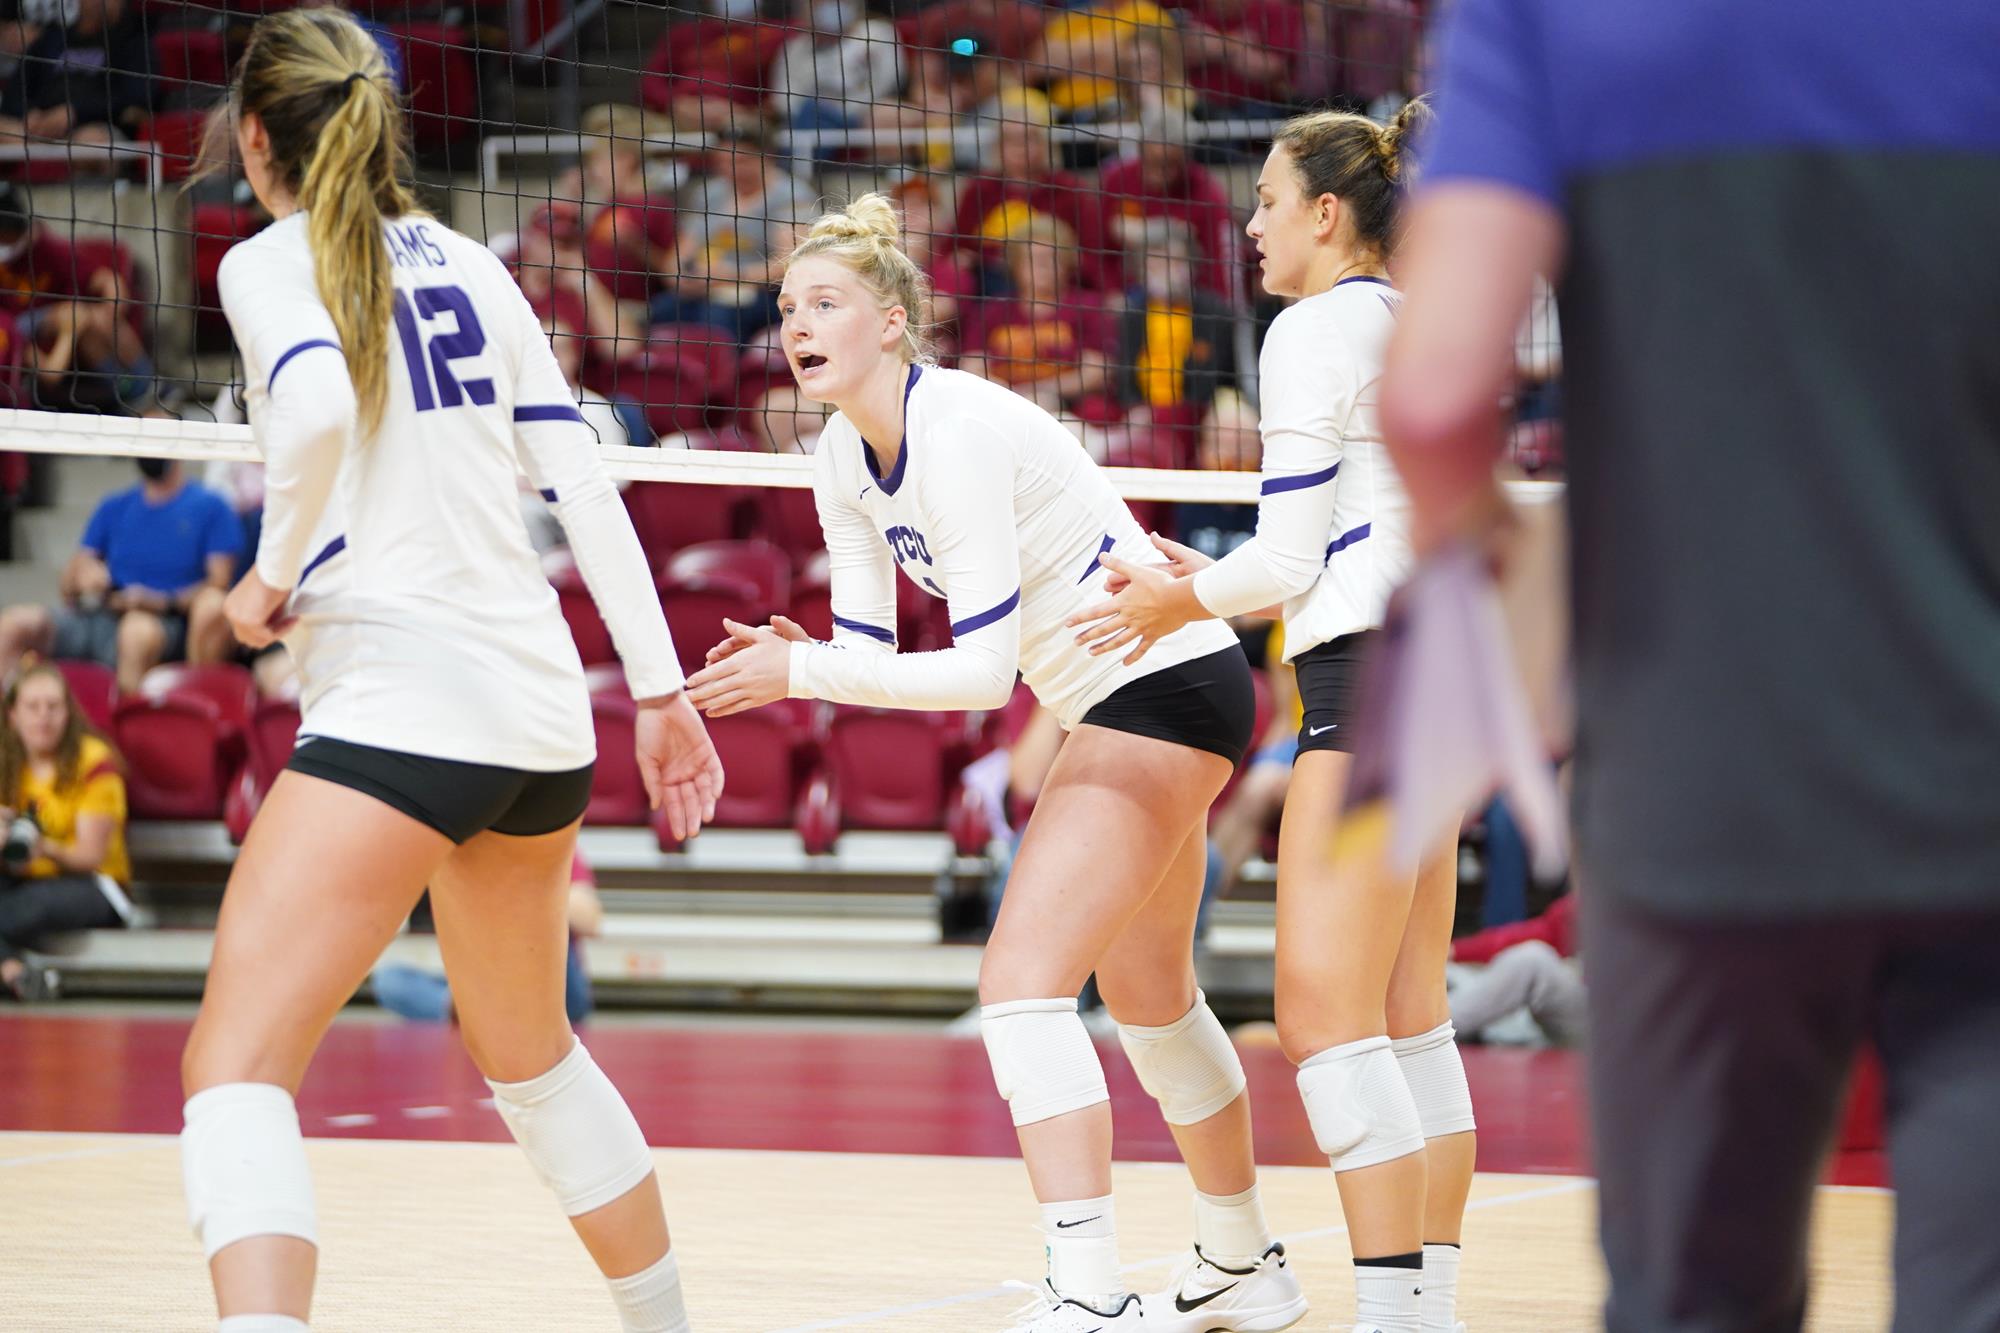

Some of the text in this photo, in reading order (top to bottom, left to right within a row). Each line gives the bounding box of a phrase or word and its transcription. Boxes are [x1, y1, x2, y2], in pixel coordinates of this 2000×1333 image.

[383, 223, 446, 268] AMS
[392, 285, 496, 412] 12
[885, 525, 933, 567] TCU
